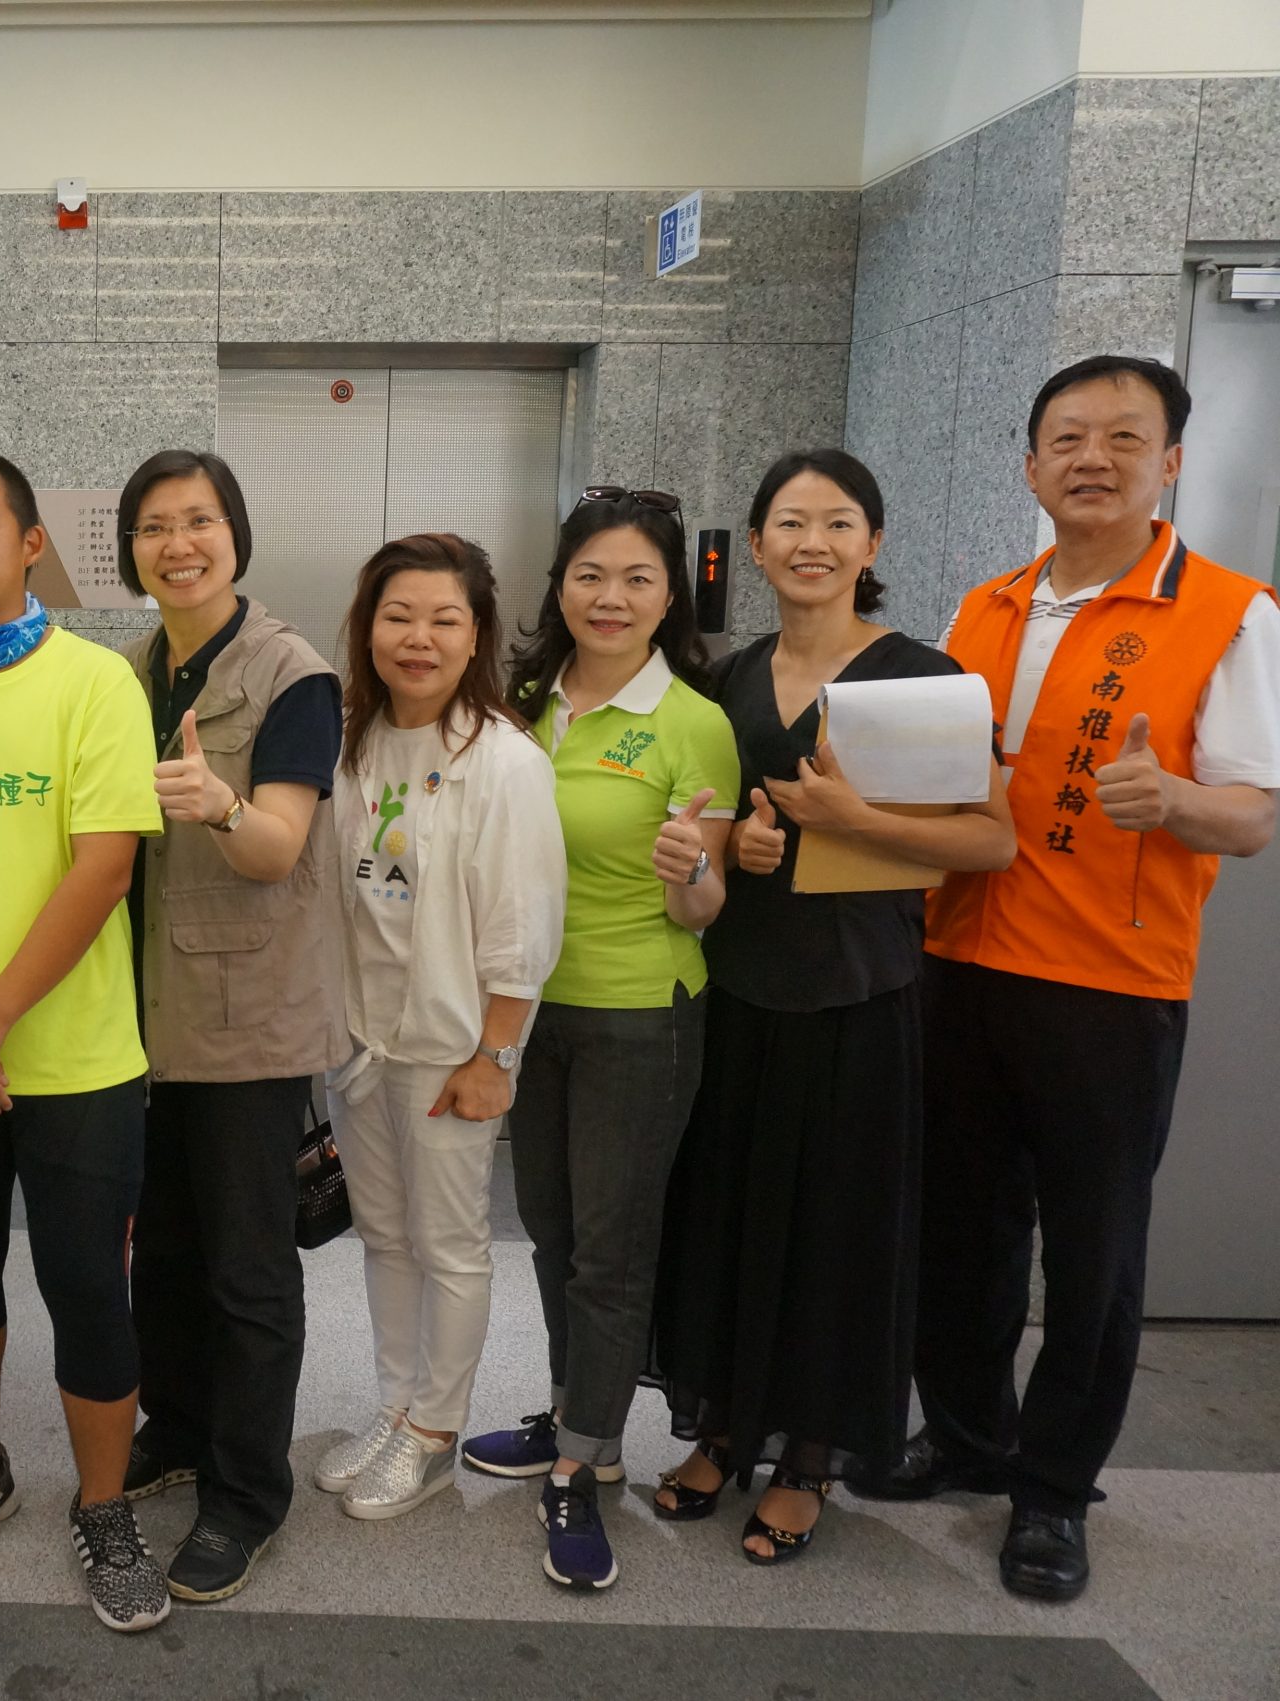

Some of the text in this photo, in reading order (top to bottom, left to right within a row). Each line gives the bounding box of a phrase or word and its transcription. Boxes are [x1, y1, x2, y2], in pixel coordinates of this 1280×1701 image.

[707, 564, 715, 581] 1
[1045, 670, 1125, 855] 南雅扶輪社
